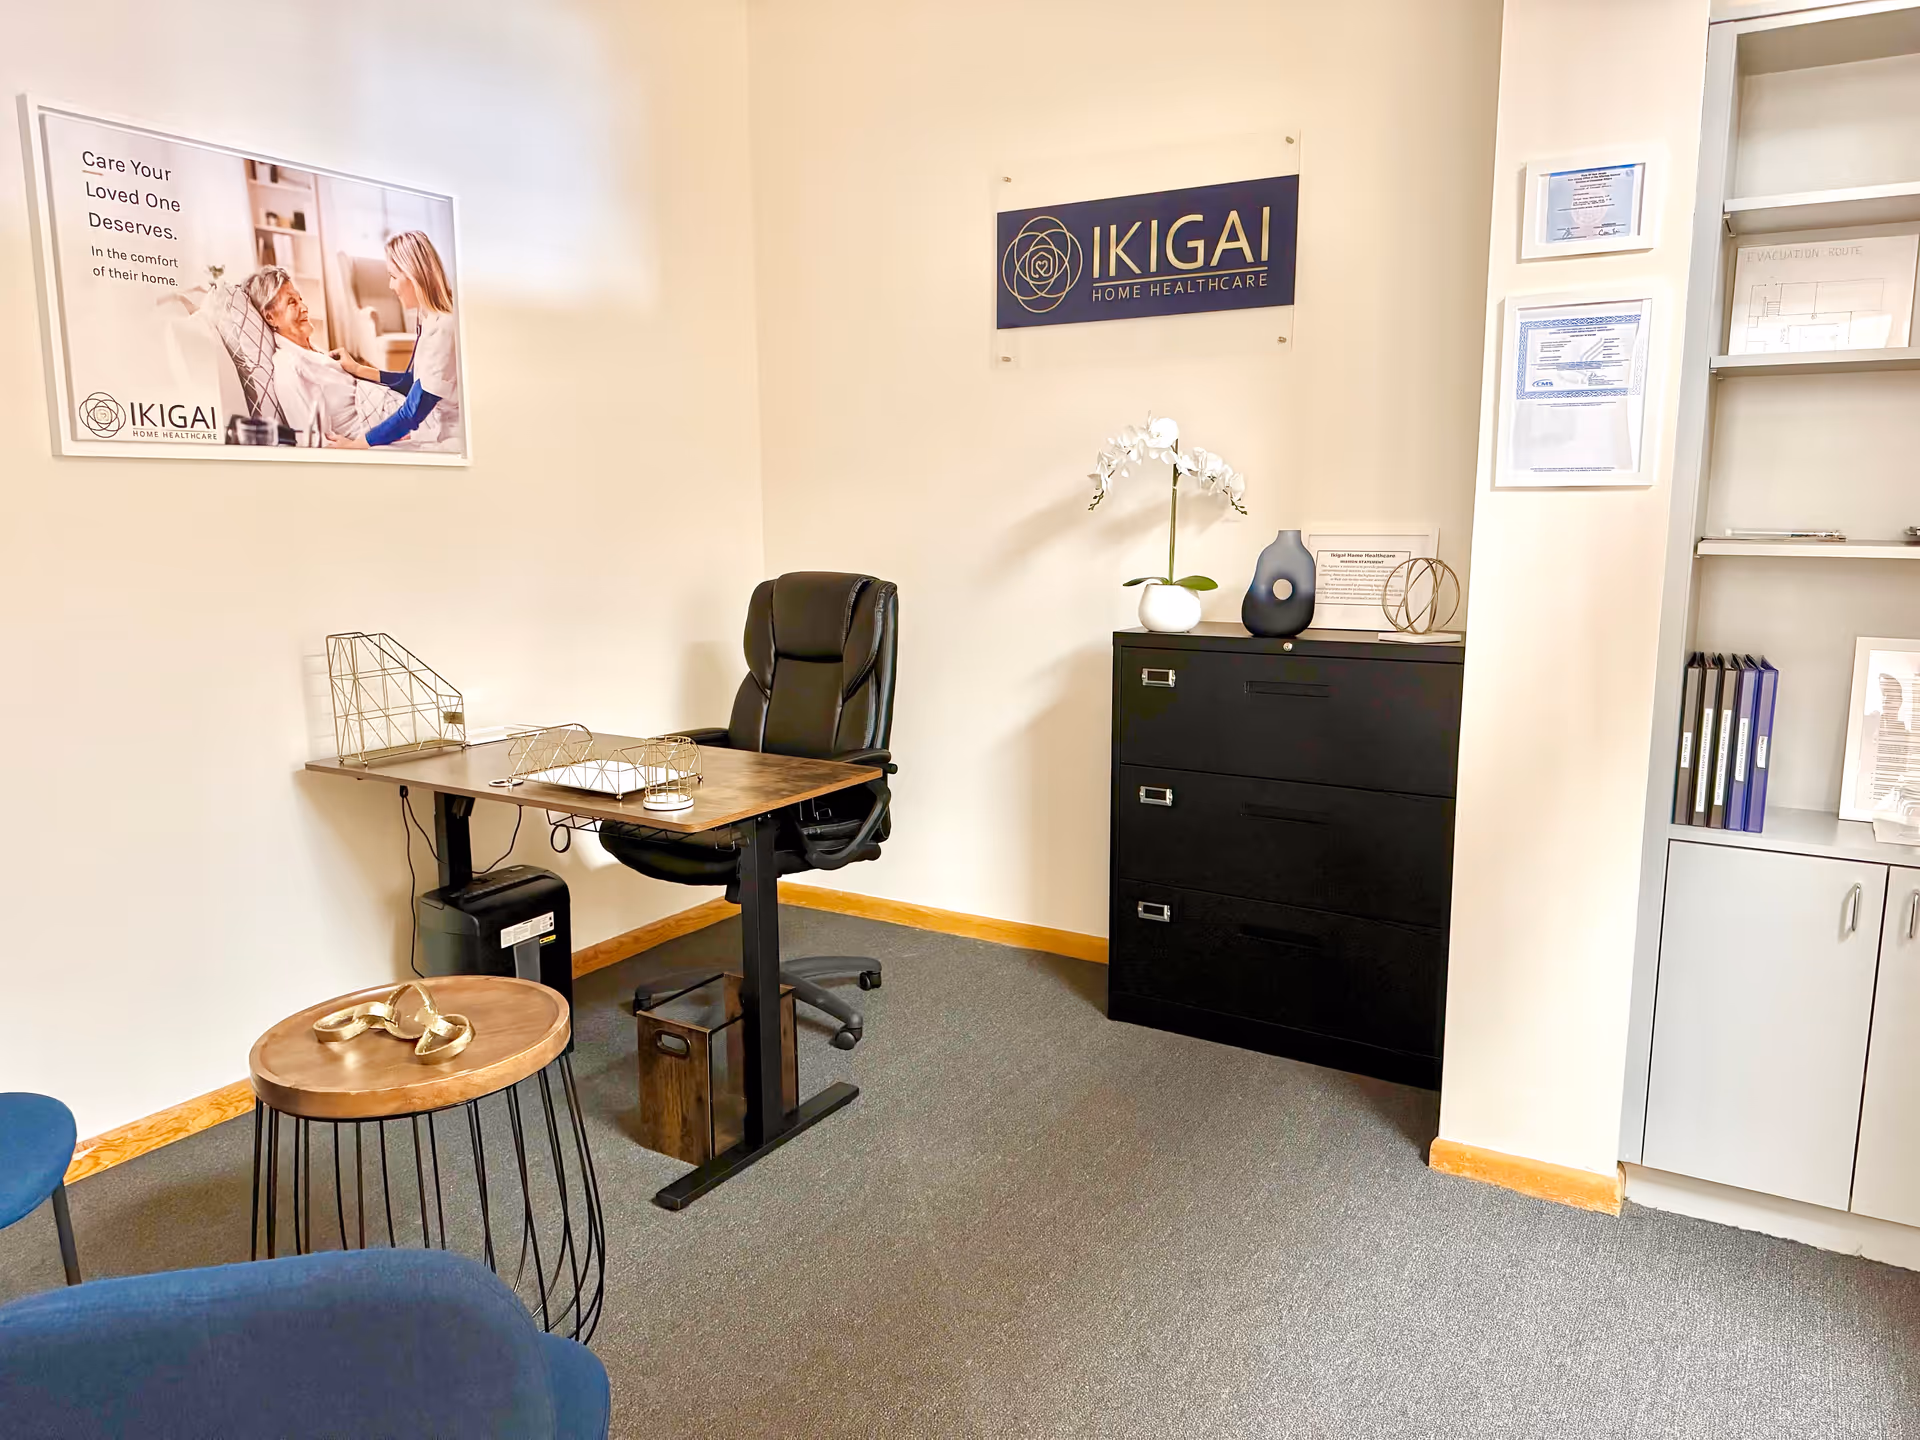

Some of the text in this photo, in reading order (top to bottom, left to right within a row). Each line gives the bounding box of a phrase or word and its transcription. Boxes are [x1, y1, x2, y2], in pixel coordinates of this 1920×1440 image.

[82, 151, 171, 181] Care Your
[86, 181, 181, 212] Loved One
[88, 212, 178, 240] Deserves.
[91, 245, 179, 268] In the comfort
[1092, 206, 1271, 279] IKIGAI
[1828, 246, 1864, 256] ROUTE
[92, 266, 179, 287] of their home.
[1092, 273, 1268, 302] HOME HEALTHCARE
[130, 402, 217, 430] IKIGAI
[132, 430, 217, 440] HOME HEALTHCARE
